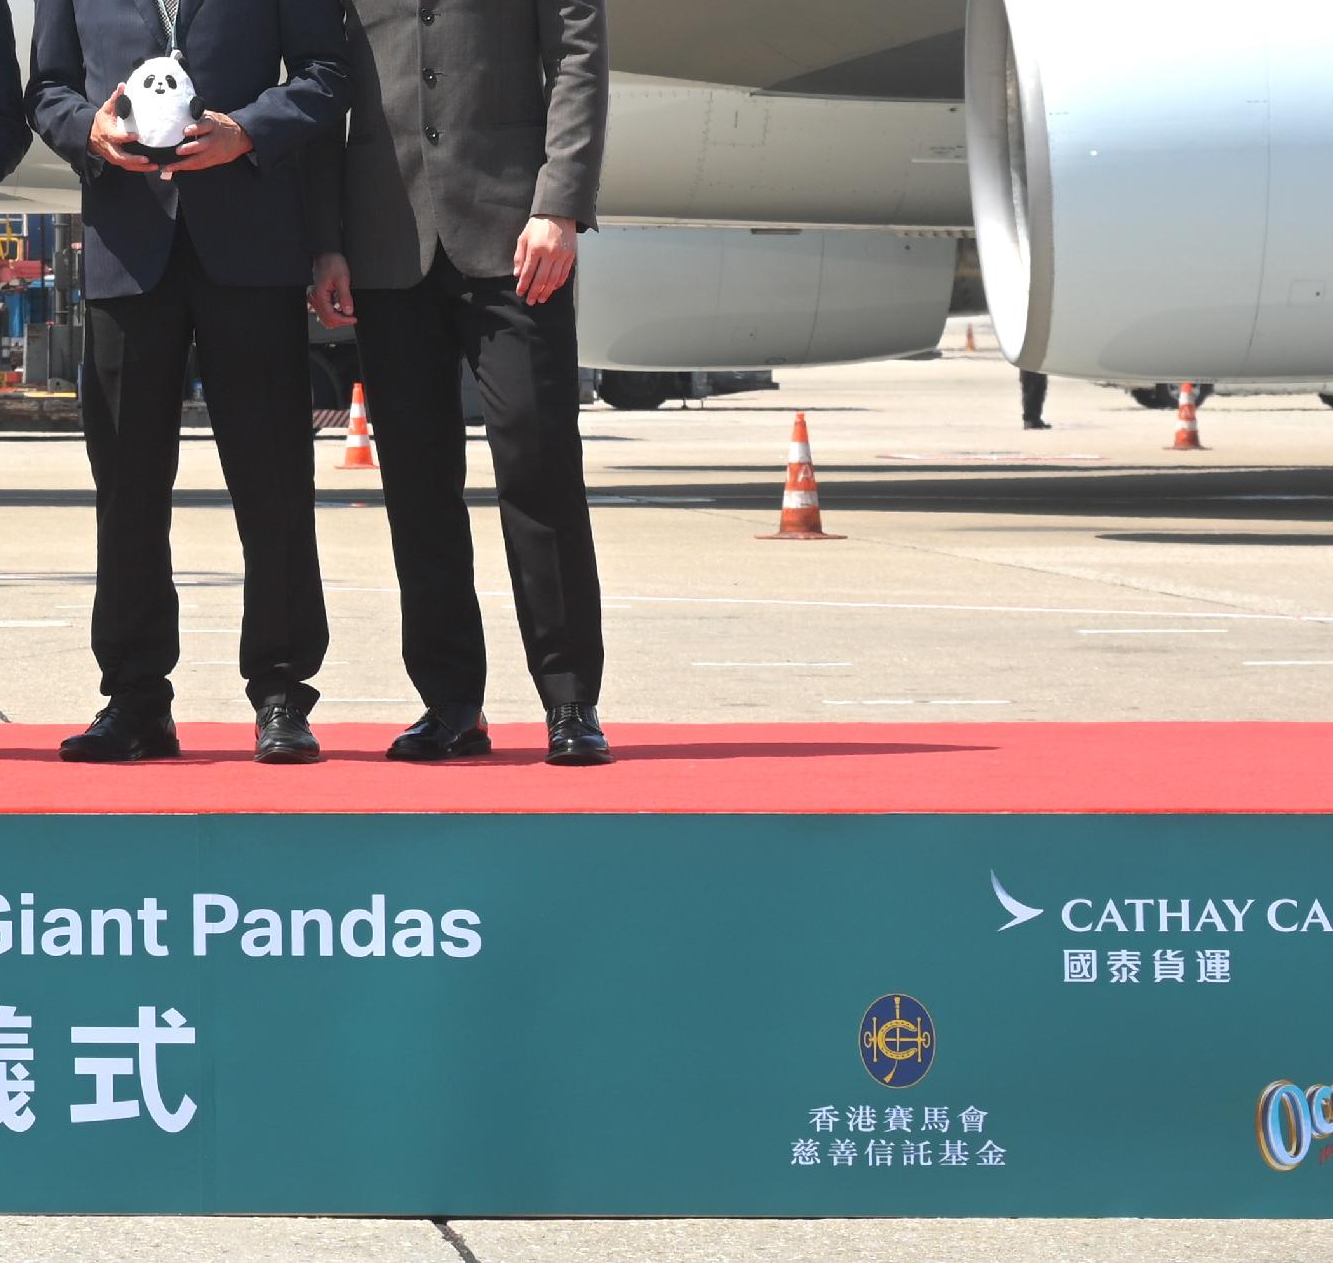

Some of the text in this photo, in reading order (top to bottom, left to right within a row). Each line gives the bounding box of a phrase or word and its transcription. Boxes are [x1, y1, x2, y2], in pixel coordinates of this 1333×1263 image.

[193, 893, 482, 958] Pandas
[1061, 898, 1255, 933] CATHAY
[1063, 949, 1231, 983] 國泰貨運
[808, 1105, 989, 1133] 香港賽馬會
[790, 1138, 1007, 1166] 慈善信託基金
